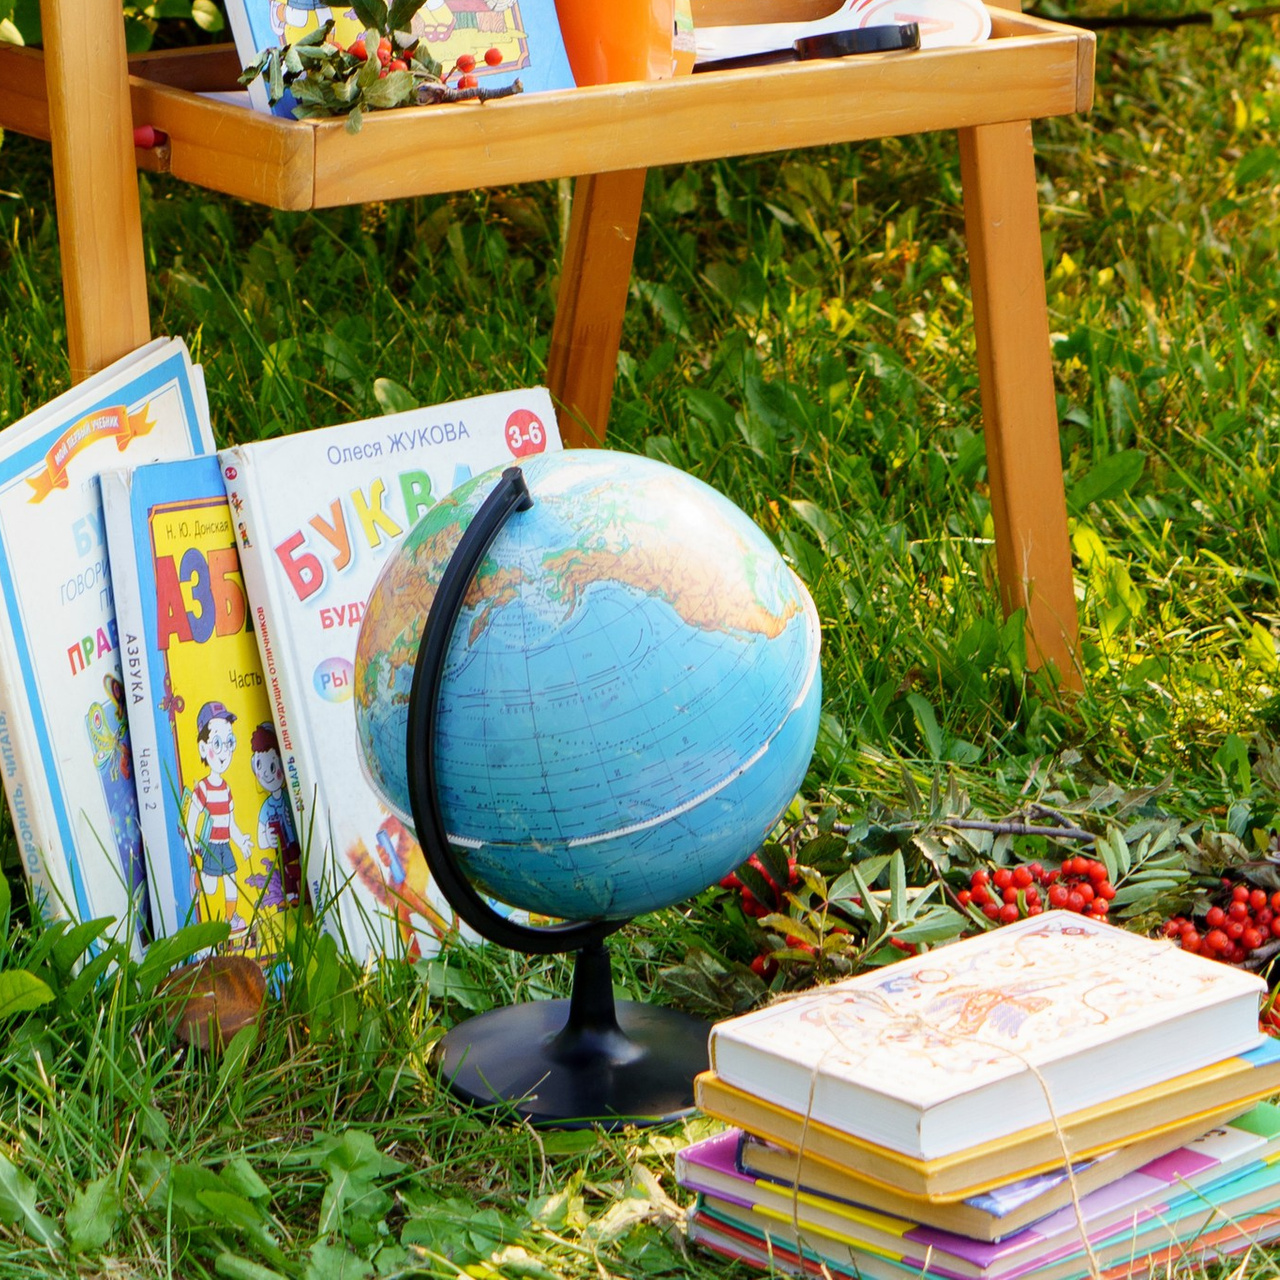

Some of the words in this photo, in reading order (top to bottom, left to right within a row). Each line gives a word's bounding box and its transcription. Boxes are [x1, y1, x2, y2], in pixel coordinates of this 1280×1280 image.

[54, 441, 69, 466] МОЙ
[66, 421, 91, 451] ПЕРВЫЙ
[92, 415, 119, 432] УЧЕБНИК
[326, 439, 383, 466] Олеся
[386, 420, 470, 454] ЖУКОВА
[507, 421, 542, 449] 3-6
[166, 524, 177, 540] Н.
[178, 521, 191, 537] Ю.
[194, 520, 230, 538] Донская
[156, 547, 254, 650] АЗБ
[319, 601, 367, 630] БУД
[256, 606, 277, 675] ОТЛИЧНИКОВ
[125, 633, 145, 705] АЗБУКА
[228, 669, 263, 690] Часть
[320, 668, 349, 691] РЫ
[270, 678, 288, 727] БУДУЩИХ
[281, 728, 293, 751] ДЛЯ
[139, 747, 151, 794] Часть
[145, 803, 157, 811] 2
[286, 755, 305, 813] БУКВАРЬ
[12, 783, 42, 874] ГОВОРИТЬ,
